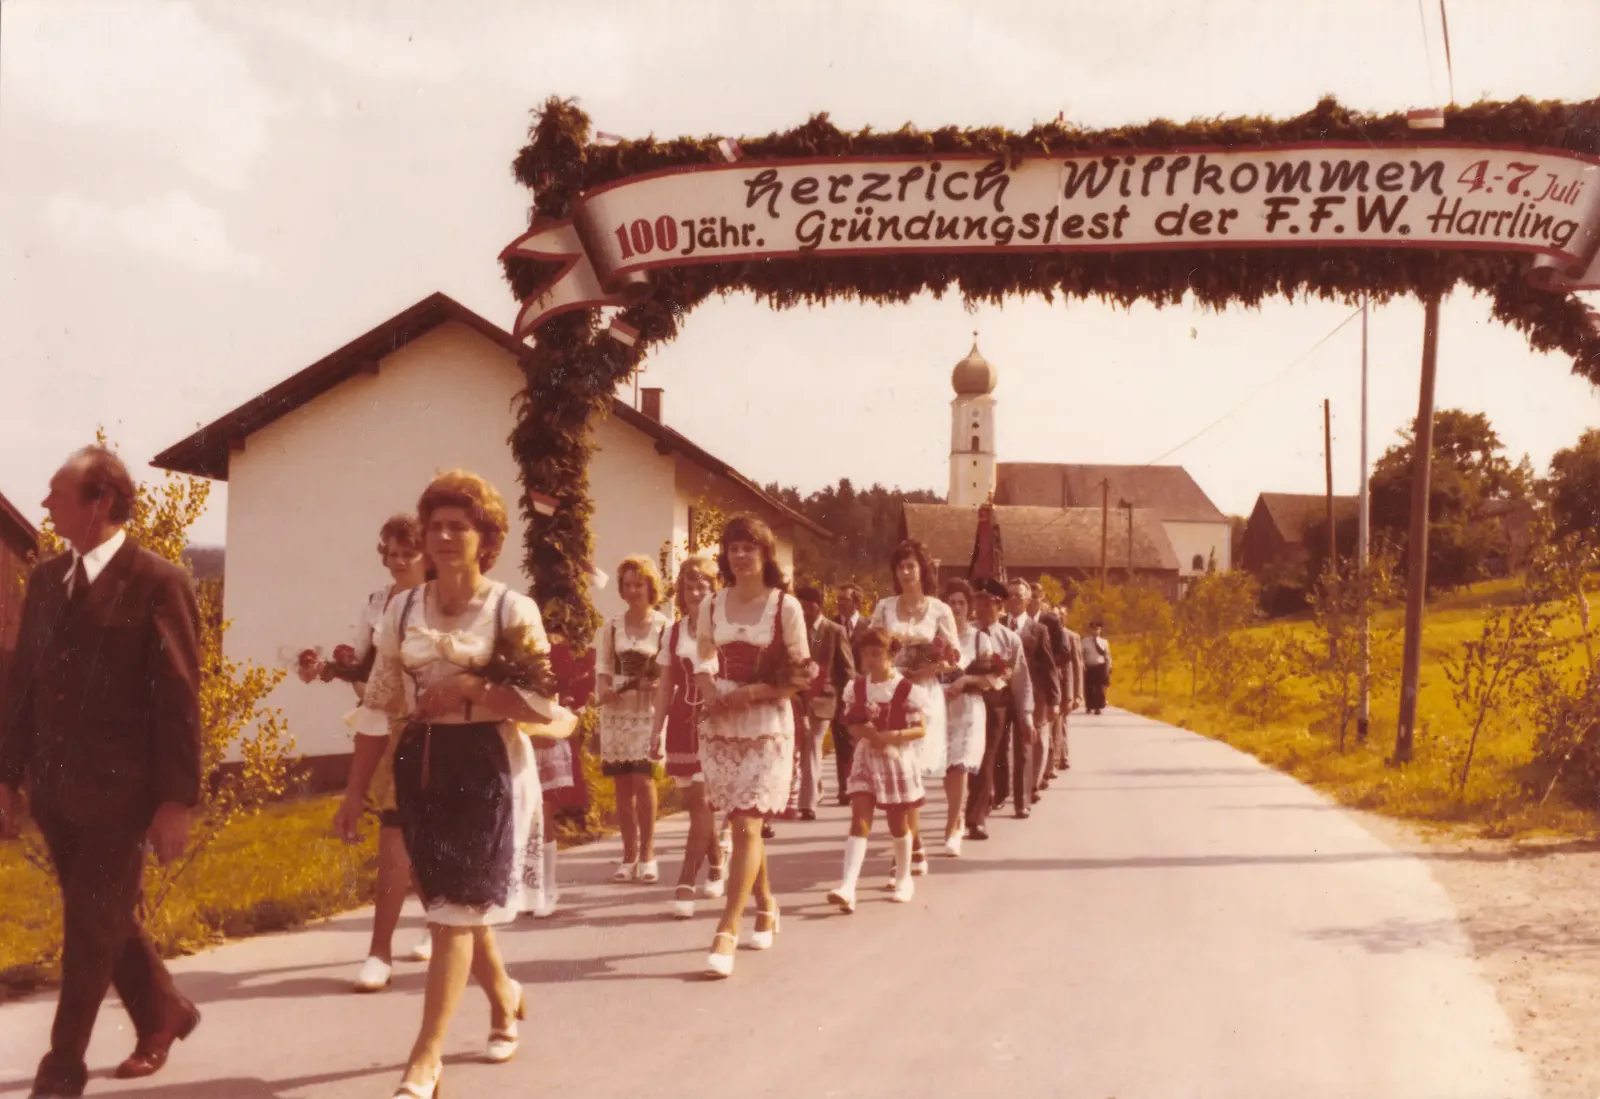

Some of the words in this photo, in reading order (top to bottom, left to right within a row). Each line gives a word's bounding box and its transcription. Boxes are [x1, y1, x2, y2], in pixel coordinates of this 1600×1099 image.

[1063, 154, 1445, 200] Willkommen
[1533, 173, 1586, 207] Juli
[614, 215, 679, 260] 100
[795, 205, 1130, 252] Gründungsfest
[1154, 202, 1239, 237] der
[1264, 195, 1411, 236] F.F.W.
[1426, 196, 1580, 249] Harrling
